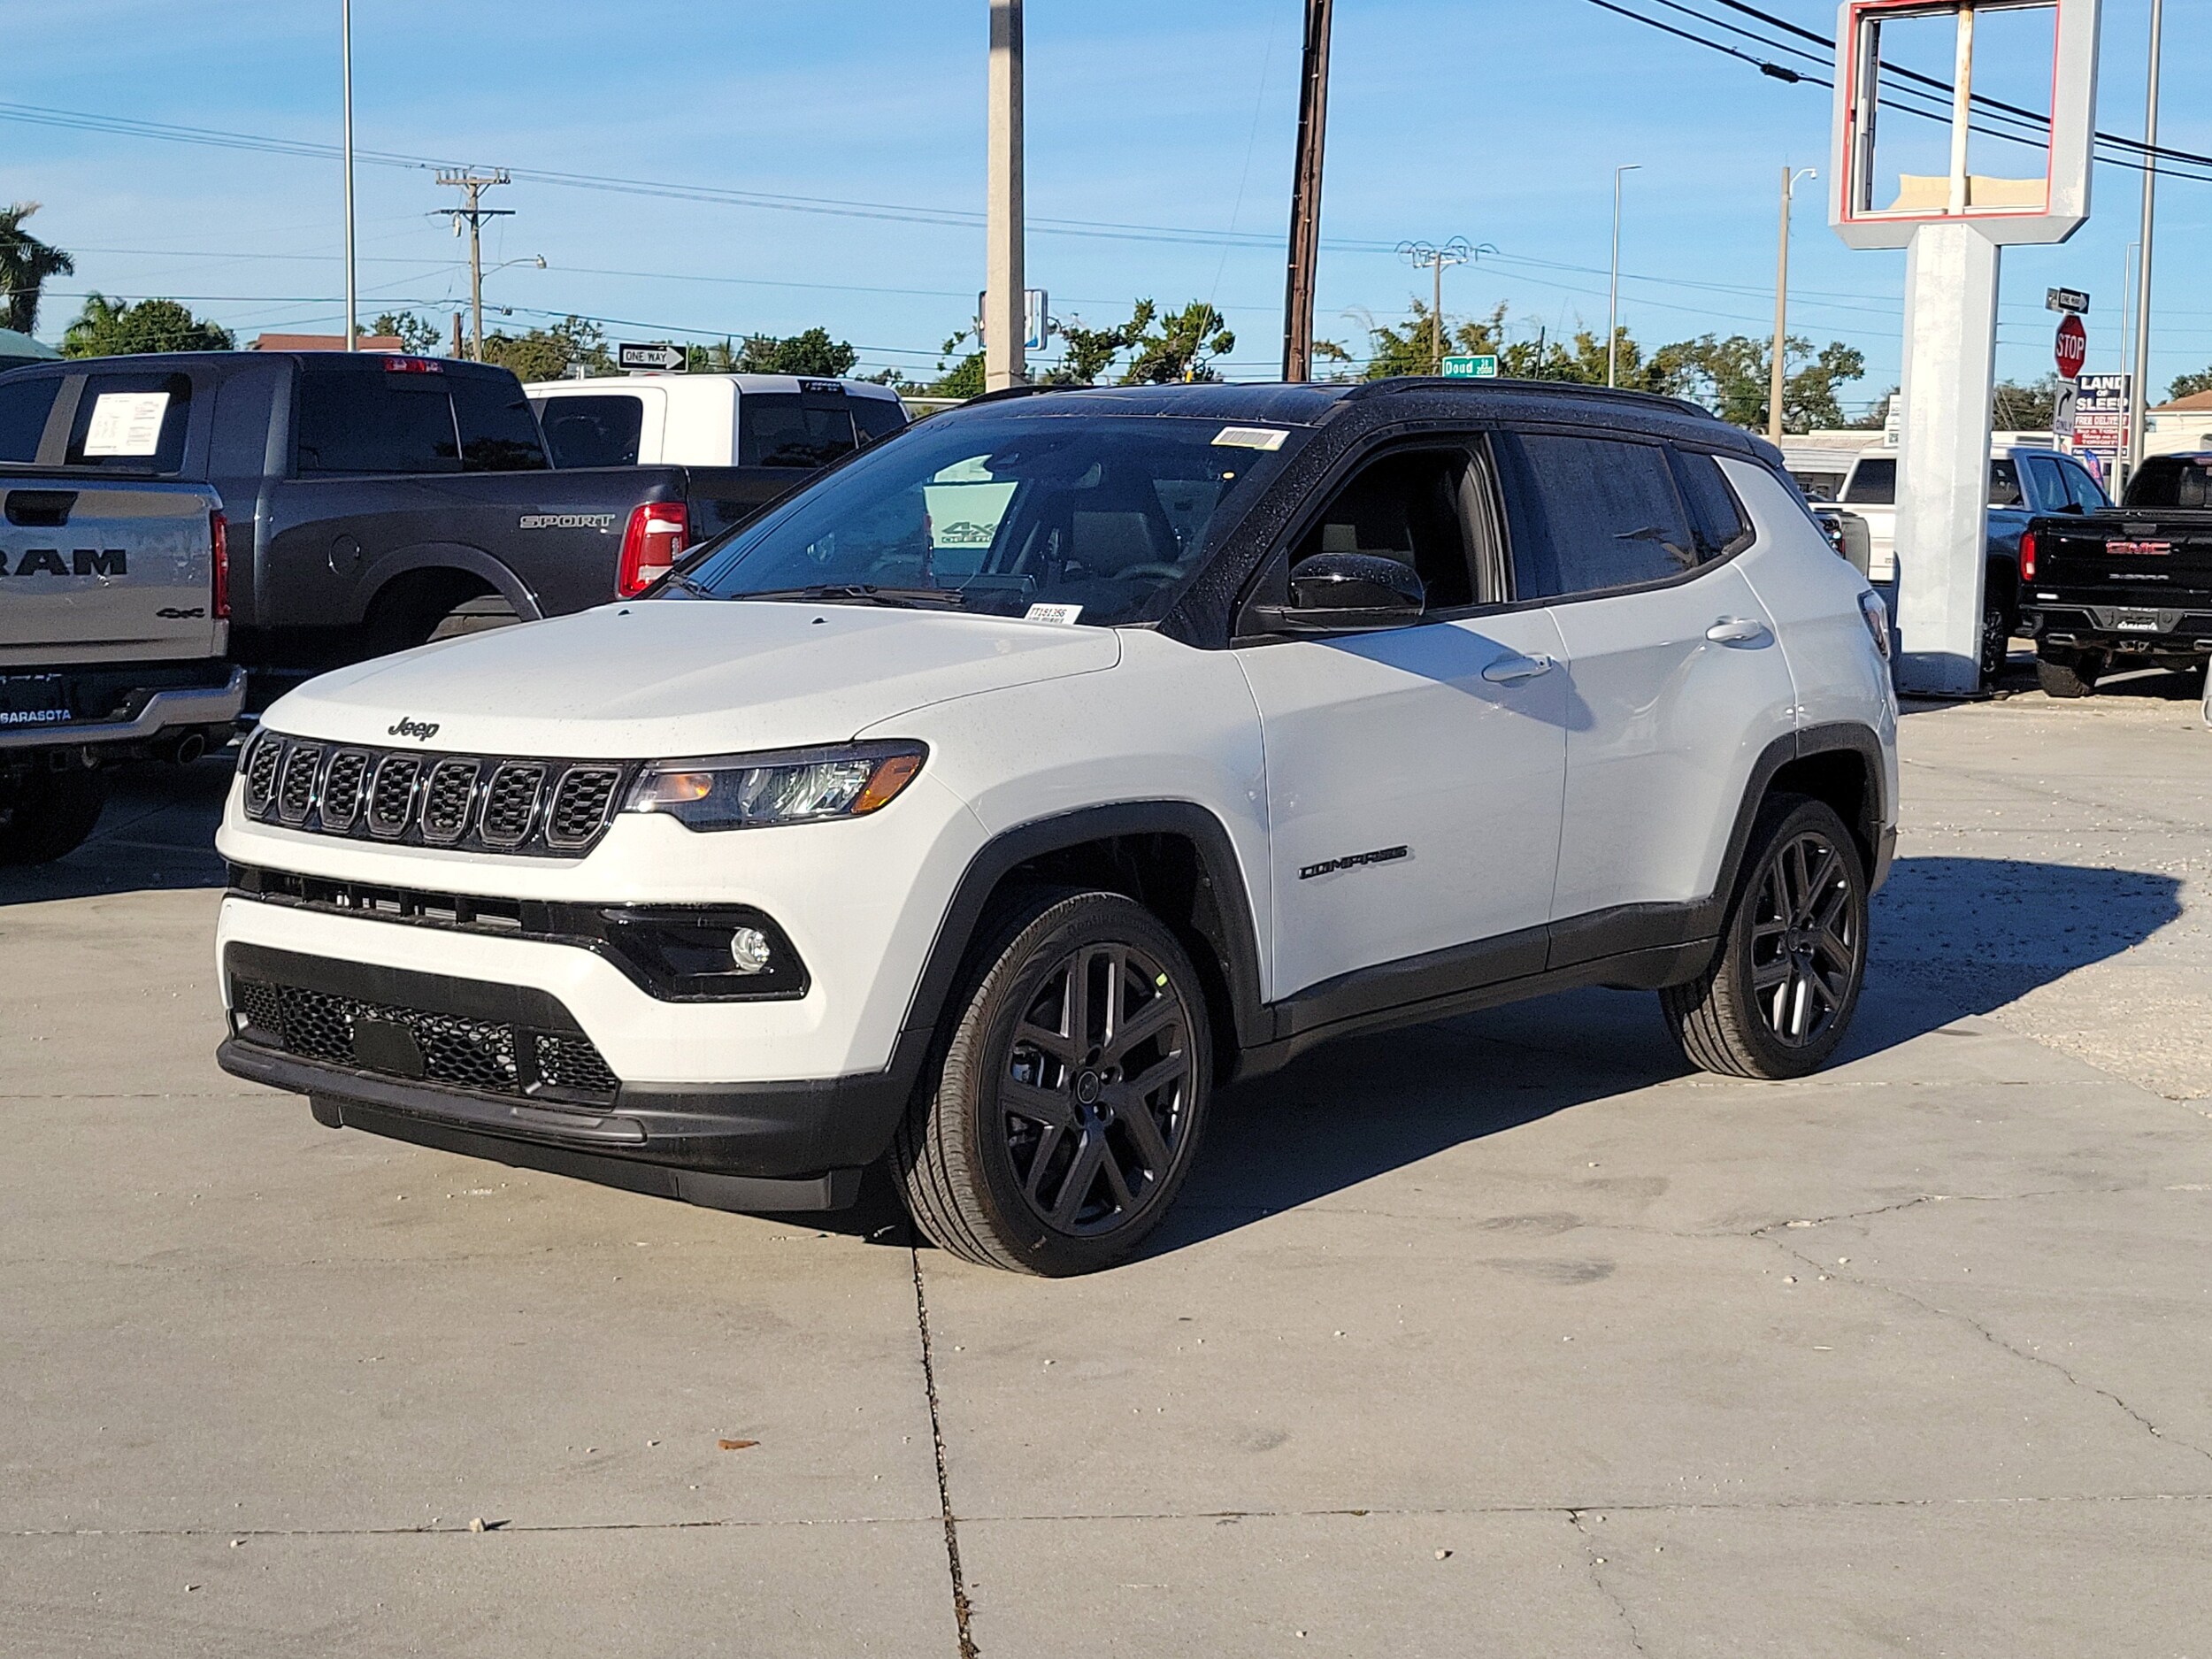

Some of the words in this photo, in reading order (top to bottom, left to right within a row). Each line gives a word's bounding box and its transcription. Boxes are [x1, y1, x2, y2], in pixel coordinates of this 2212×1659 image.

[2056, 333, 2085, 360] STOP
[626, 350, 645, 362] ONE
[647, 352, 667, 363] WAY
[1446, 361, 1473, 374] Doud
[2076, 397, 2128, 411] SLEEP
[2055, 419, 2073, 433] ONLY
[2075, 415, 2093, 426] FREE
[520, 514, 616, 529] SPORT
[0, 549, 127, 576] AM
[0, 709, 72, 725] SARASOTA
[388, 716, 441, 741] Jeep
[1298, 845, 1408, 879] COMPASS
